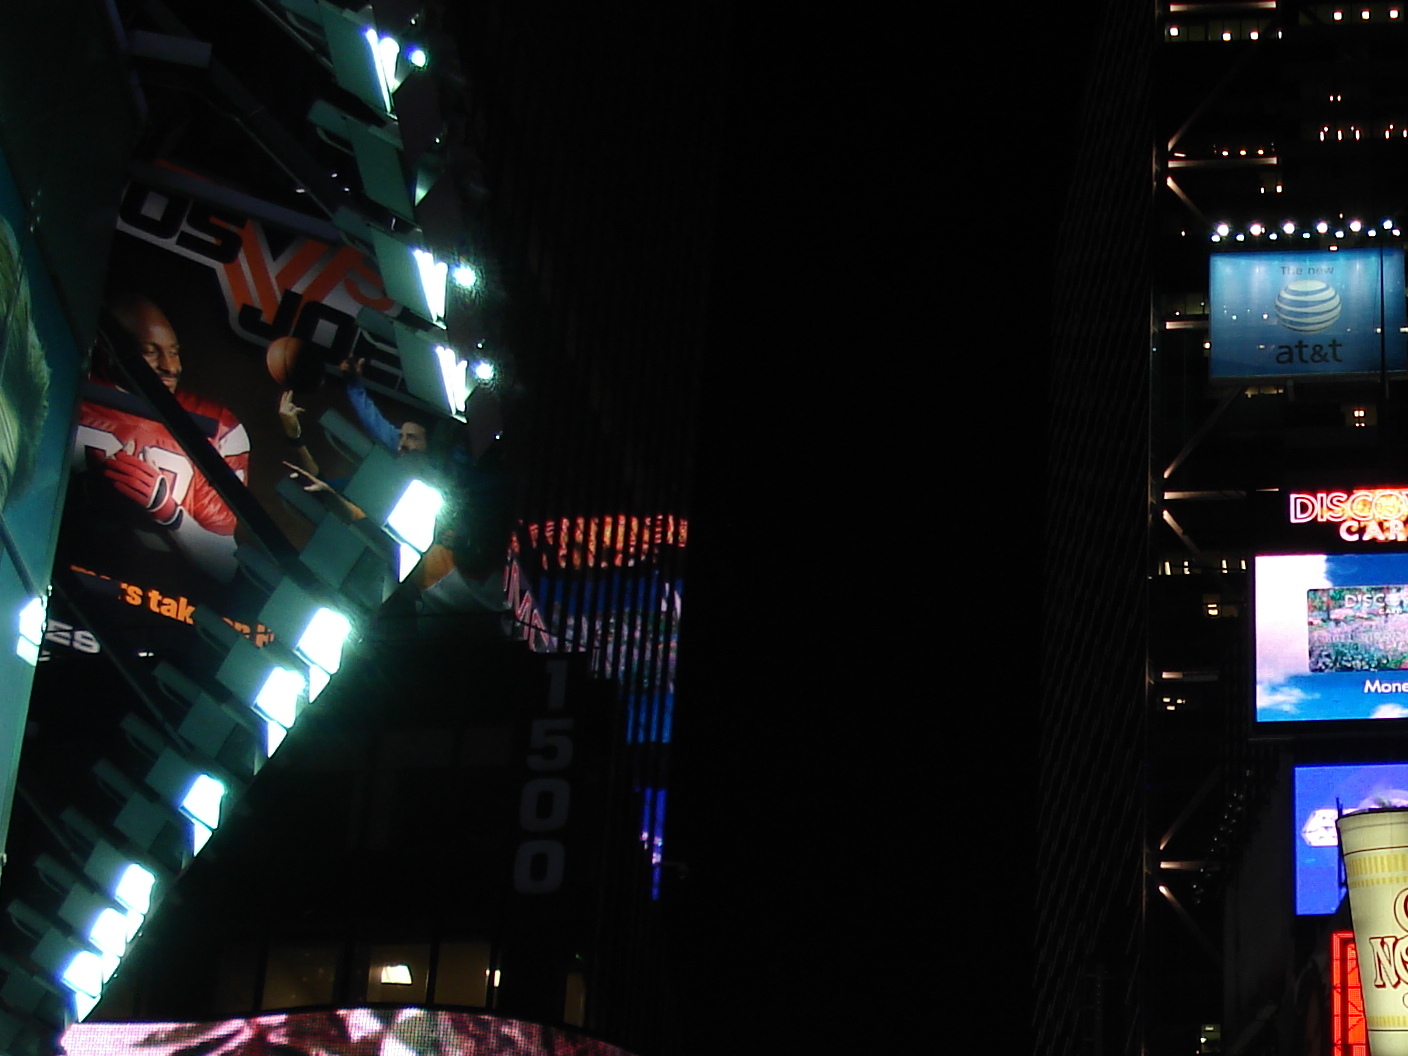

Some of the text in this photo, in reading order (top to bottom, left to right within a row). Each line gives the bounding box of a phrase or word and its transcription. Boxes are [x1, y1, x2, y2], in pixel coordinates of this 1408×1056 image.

[1281, 266, 1335, 276] The new
[1275, 339, 1343, 365] at&t
[513, 658, 574, 895] 1500
